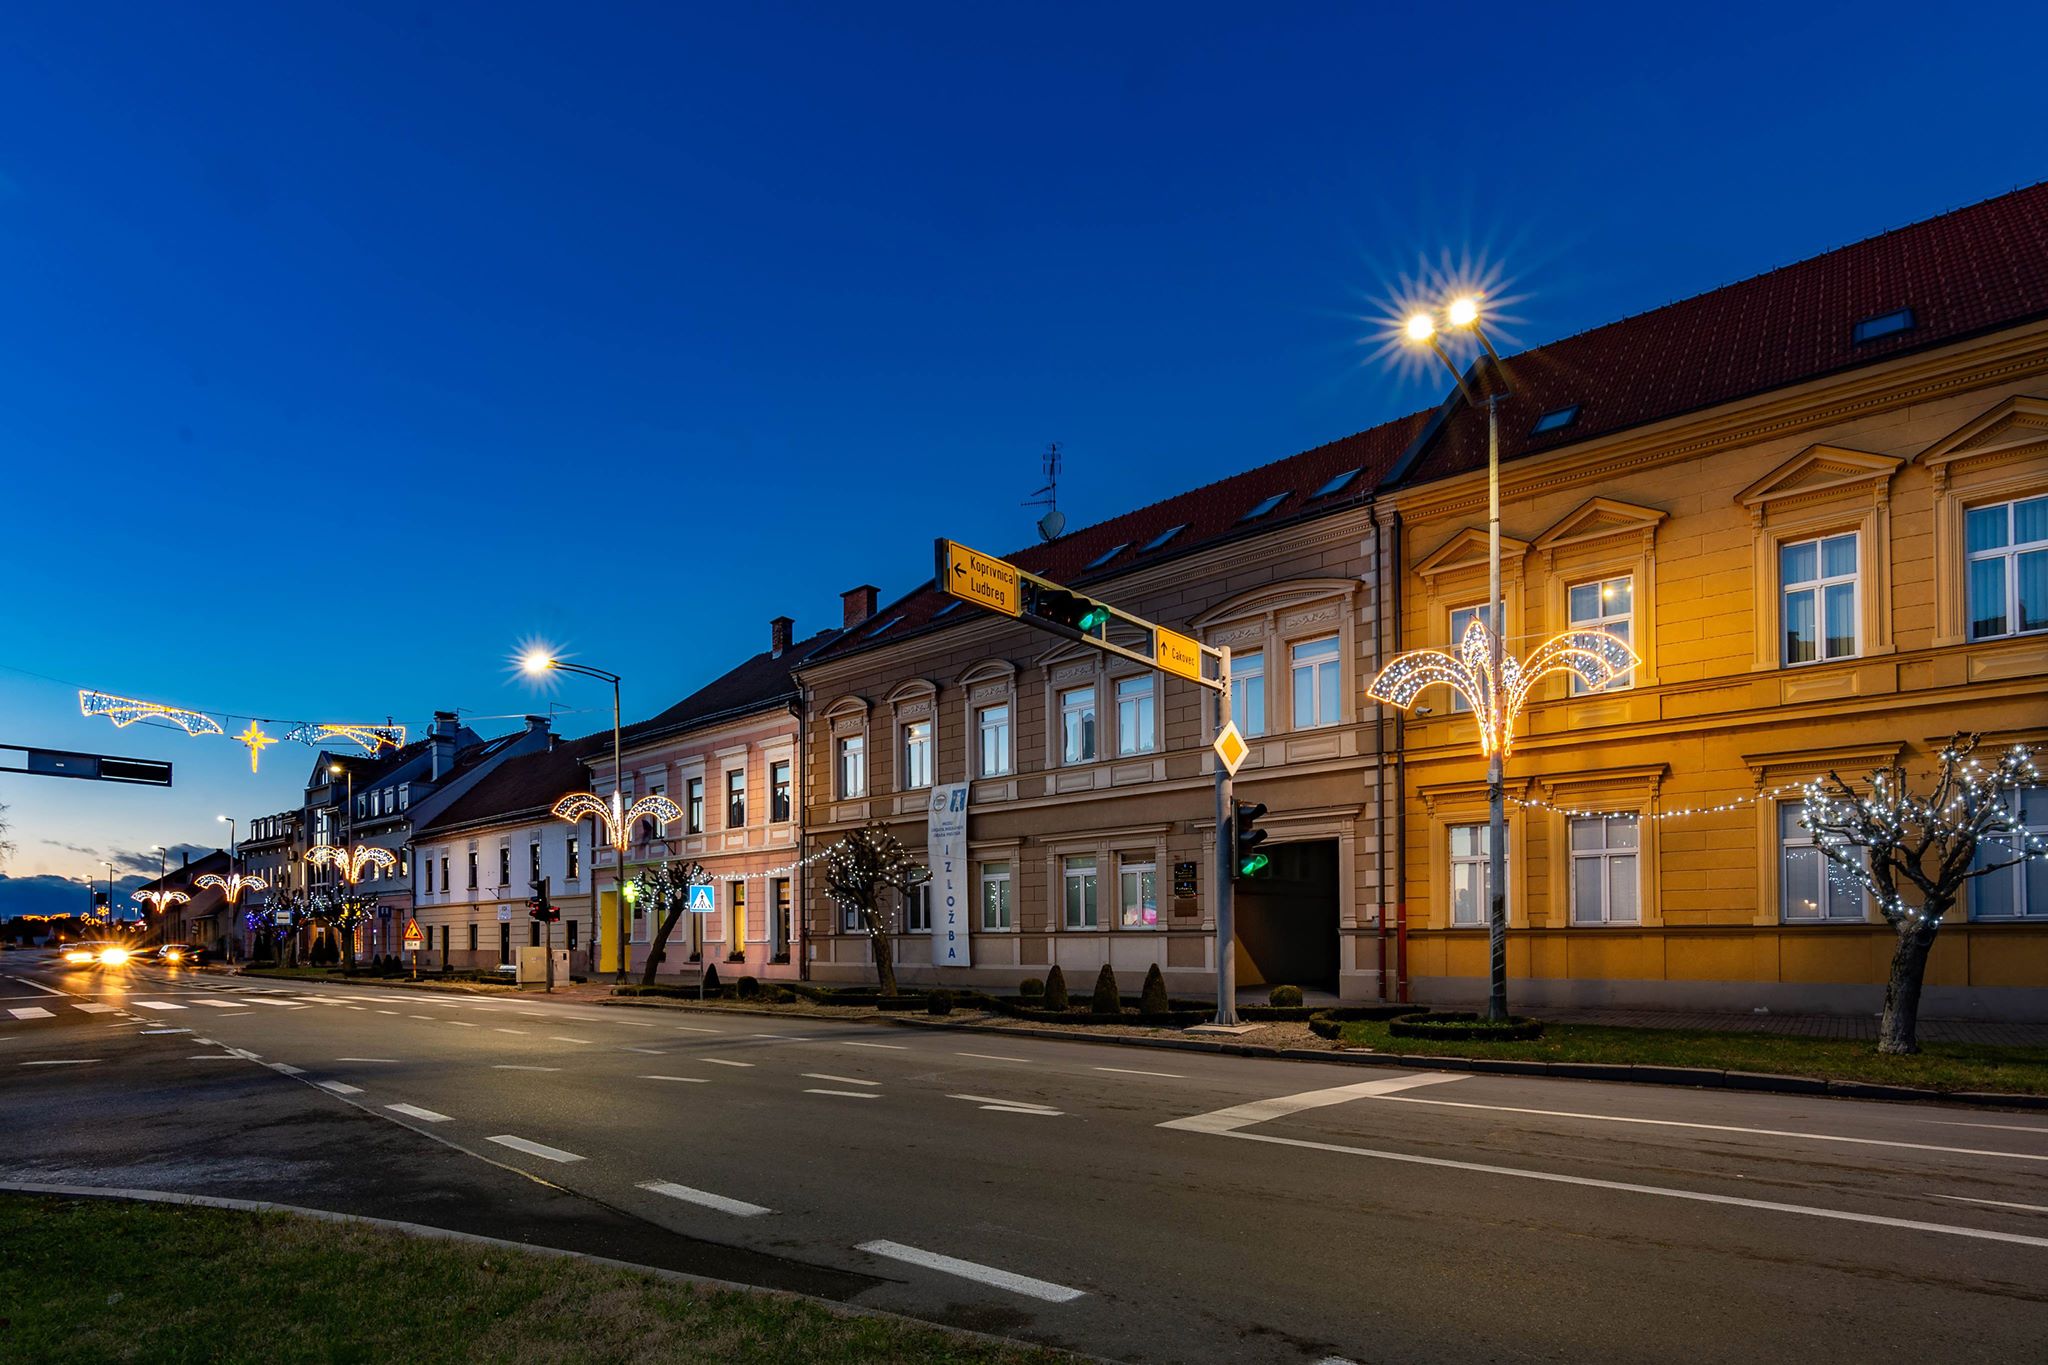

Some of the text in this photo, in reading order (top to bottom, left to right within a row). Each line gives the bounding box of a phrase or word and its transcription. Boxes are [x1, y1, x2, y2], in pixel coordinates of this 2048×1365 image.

[970, 555, 1013, 584] Koprivnica
[970, 577, 1004, 605] Ludbreg
[944, 844, 956, 958] IZLOŽBA
